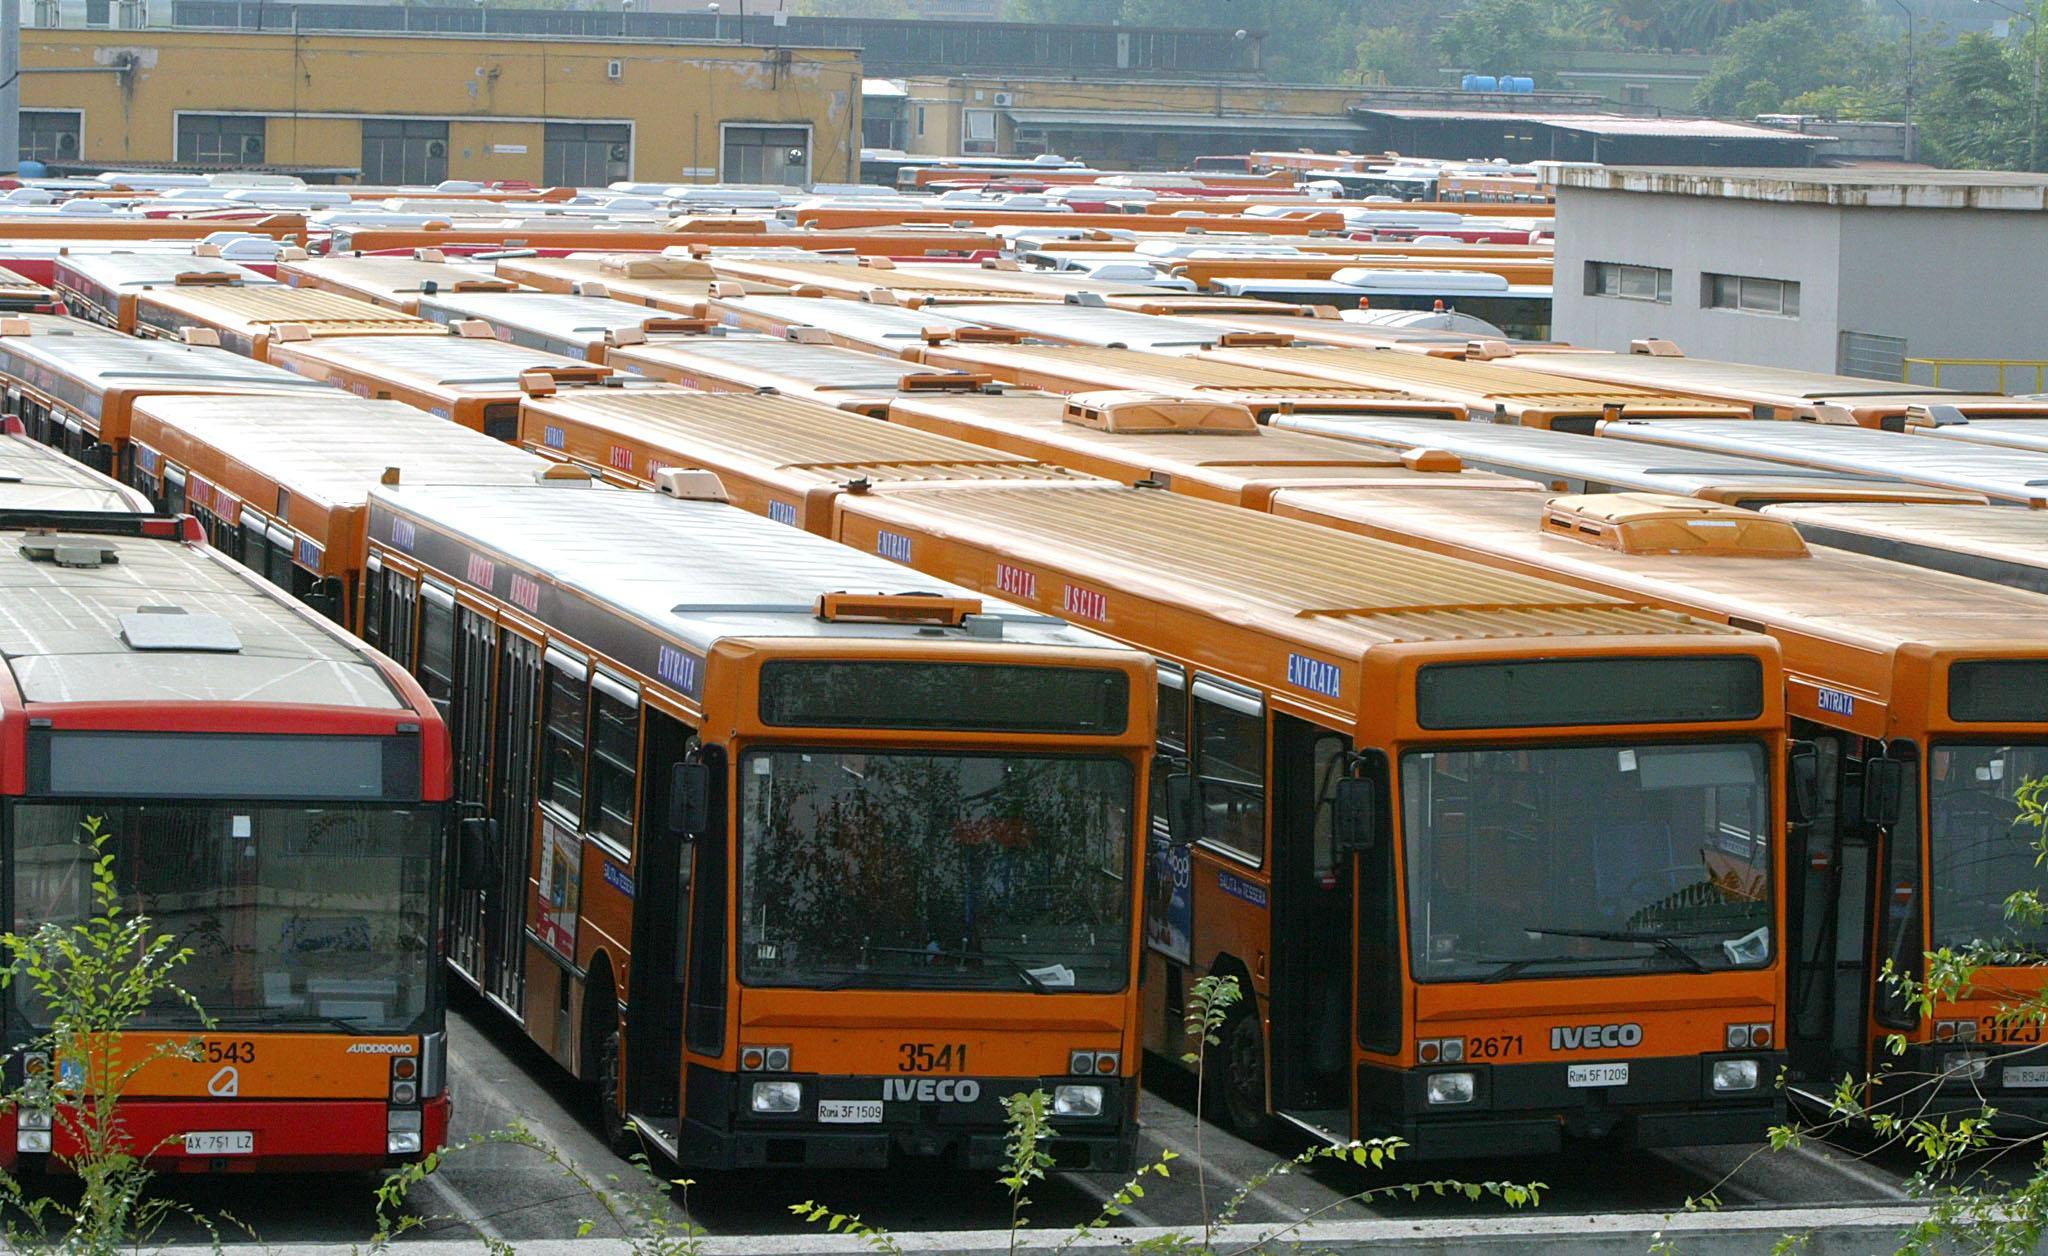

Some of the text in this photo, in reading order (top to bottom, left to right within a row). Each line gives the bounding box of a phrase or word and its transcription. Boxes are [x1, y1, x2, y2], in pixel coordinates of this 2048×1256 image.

[877, 530, 912, 562] ENTRATA
[997, 563, 1036, 600] USCITA
[1064, 584, 1106, 622] USCITA
[658, 645, 695, 691] ENTRATA
[1288, 653, 1340, 698] ENTRATA
[1818, 688, 1853, 716] ENTRATA
[346, 1044, 412, 1054] AUTODROMO
[1470, 1036, 1523, 1058] 2671
[1551, 1023, 1642, 1050] IVECO
[899, 1043, 966, 1072] 3541
[883, 1079, 980, 1103] IVECO
